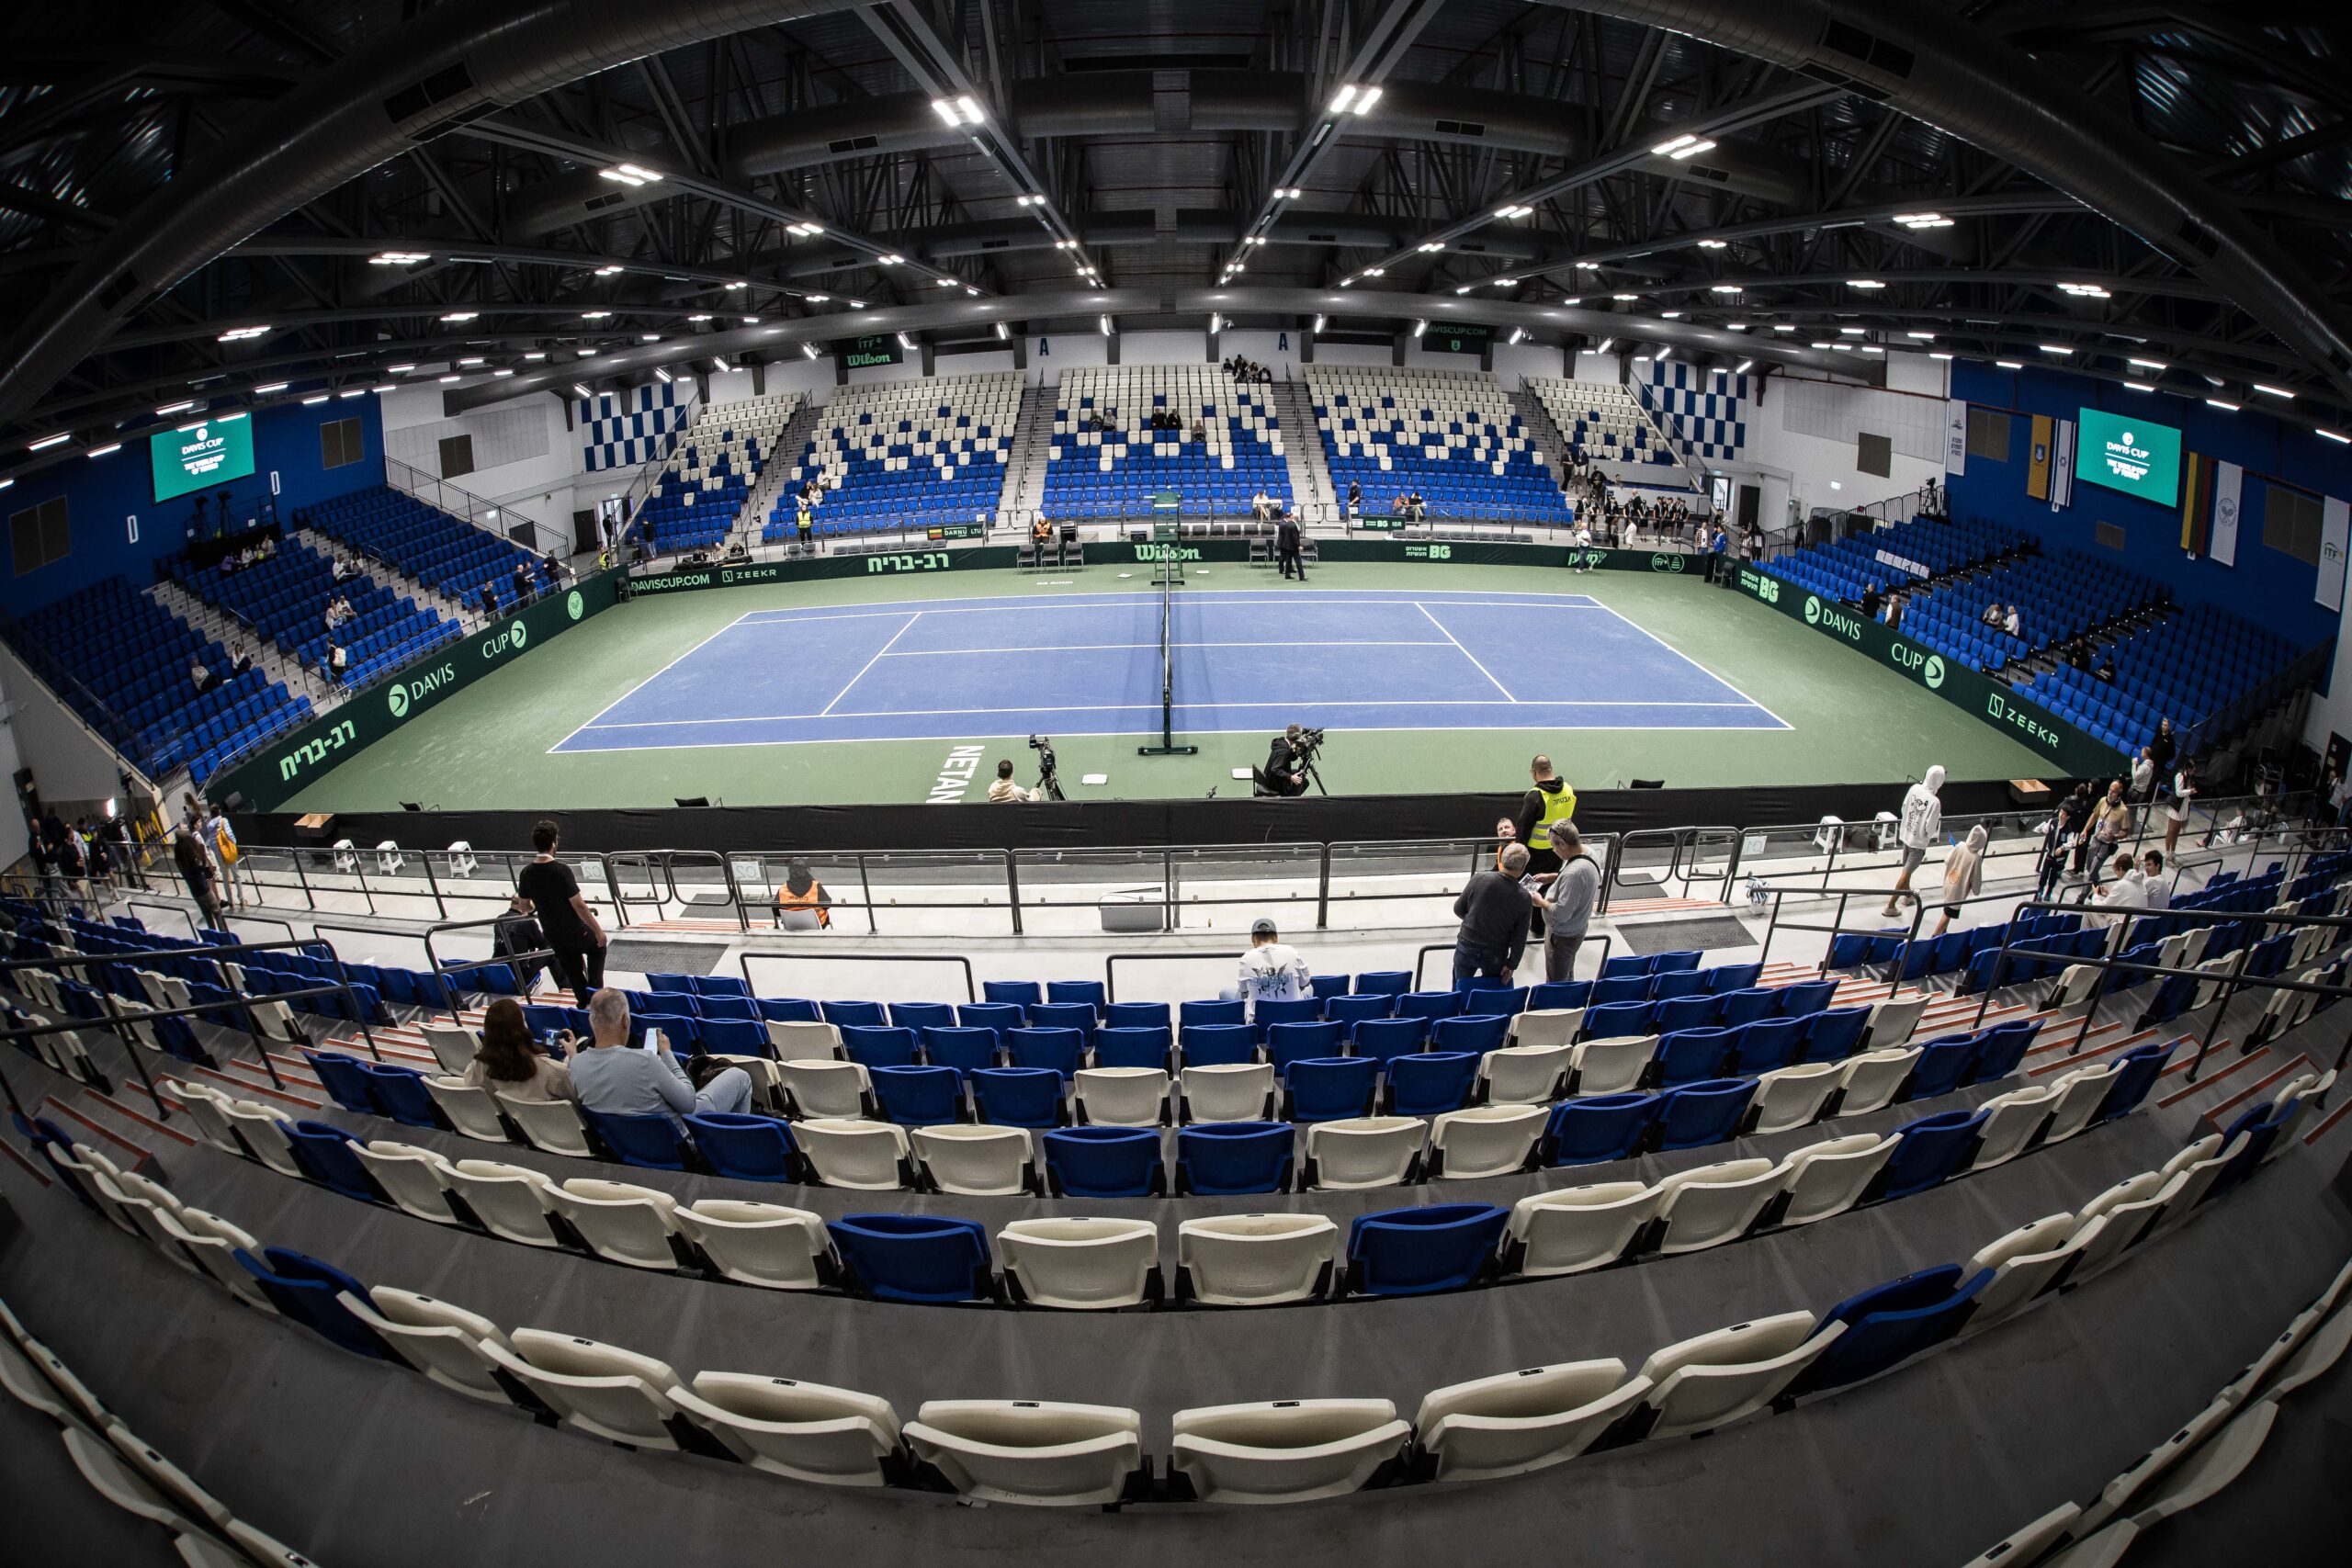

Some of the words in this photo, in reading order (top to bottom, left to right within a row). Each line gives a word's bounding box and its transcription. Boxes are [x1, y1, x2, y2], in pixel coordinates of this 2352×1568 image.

[1425, 325, 1487, 336] AVISCUP.COM
[858, 339, 875, 349] ITF
[1039, 337, 1049, 356] A
[1278, 332, 1288, 351] A
[847, 353, 891, 367] Wilson
[181, 442, 207, 455] DAVIS
[2106, 441, 2131, 455] DAVIS
[2131, 446, 2150, 459] CUP
[1429, 545, 1452, 558] BG
[2324, 546, 2338, 559] ITF
[867, 553, 950, 572] רב-בריח
[631, 574, 710, 591] DAVISCUP.COM
[736, 569, 777, 579] ZEEKR
[1758, 576, 1780, 603] BG
[1823, 608, 1861, 640] DAVIS
[1891, 643, 1923, 671] CUP
[411, 662, 455, 701] DAVIS
[482, 633, 508, 659] CUP
[2007, 707, 2059, 748] ZEEKR
[279, 719, 356, 781] רב-בריח
[925, 745, 985, 804] NETAN
[1553, 795, 1571, 806] אבטחה
